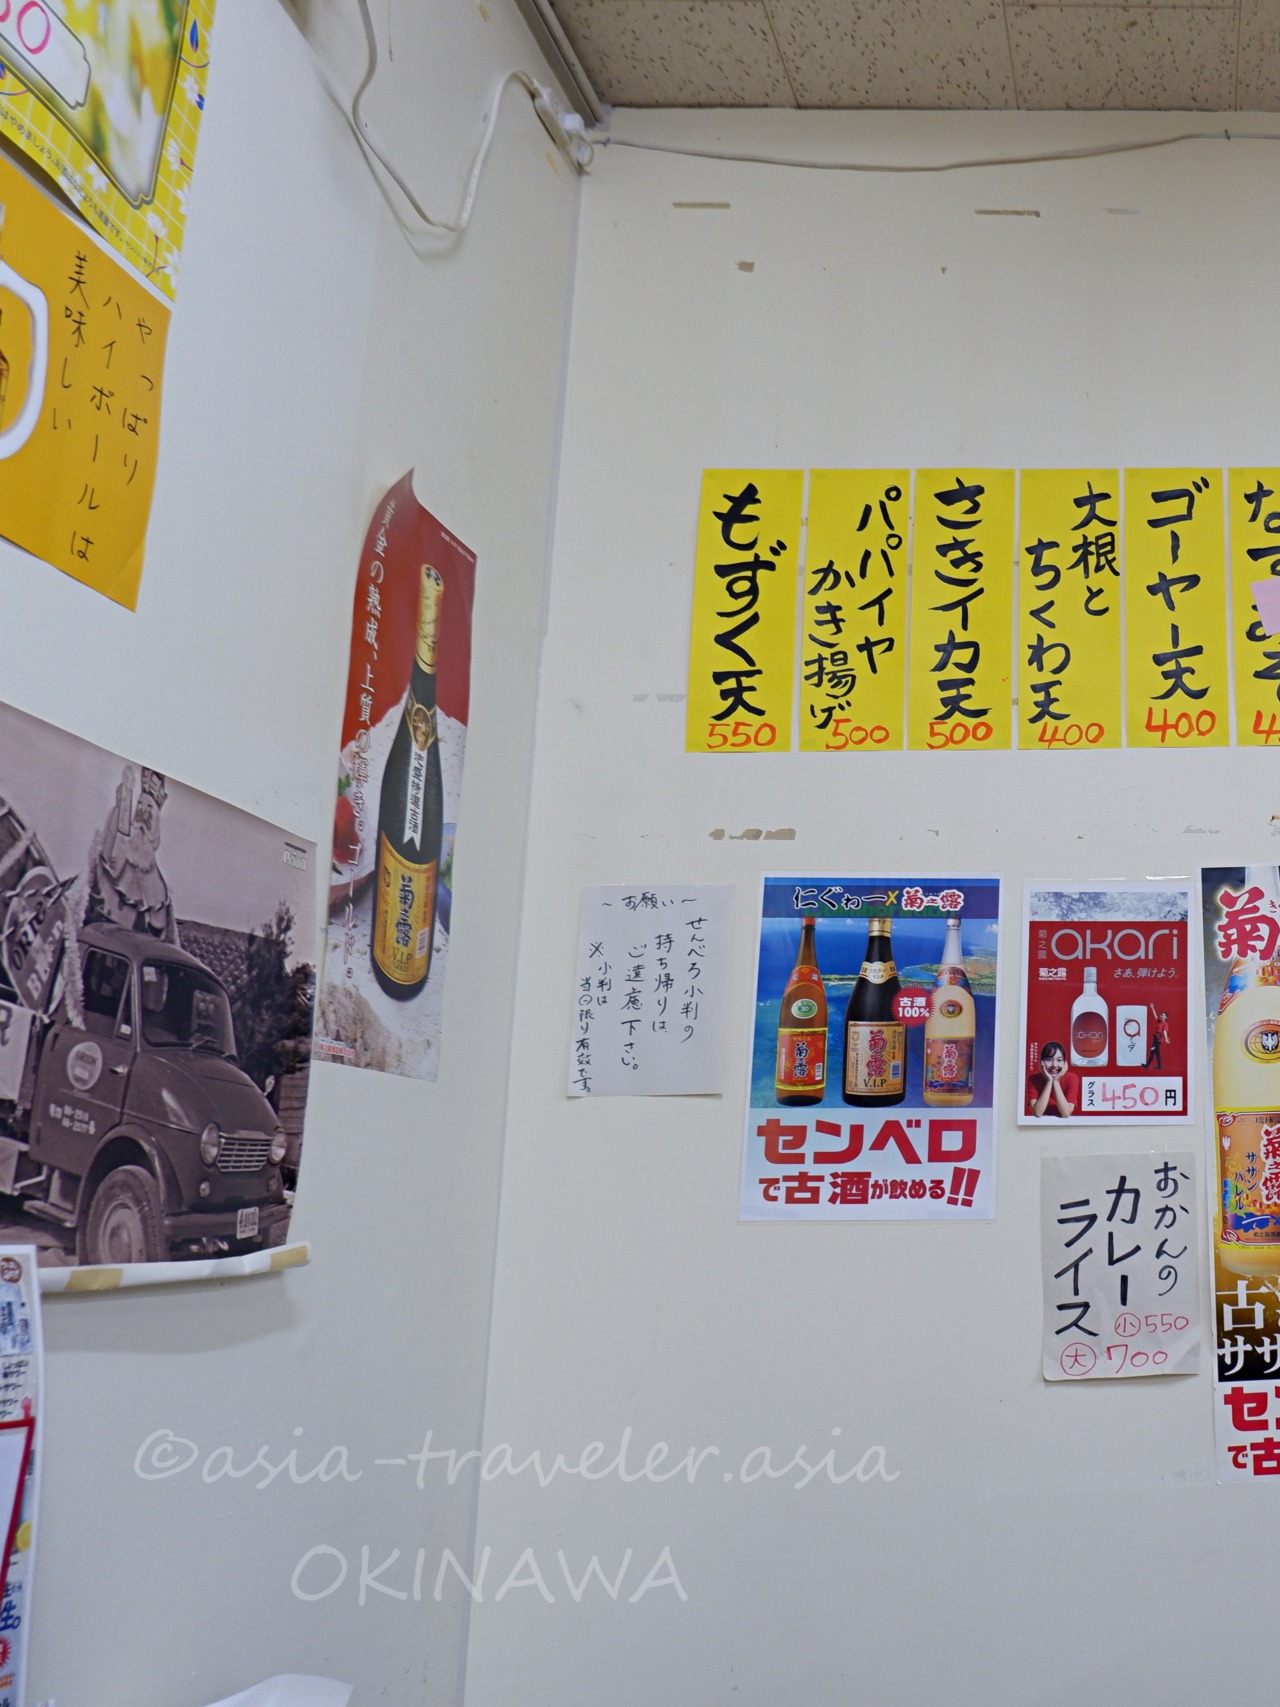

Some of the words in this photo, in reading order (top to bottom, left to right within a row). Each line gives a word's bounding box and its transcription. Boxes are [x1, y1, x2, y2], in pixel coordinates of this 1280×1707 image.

[51, 250, 90, 431] 美味しい
[121, 316, 155, 485] やっぱり
[70, 295, 123, 562] ハイボールは
[1067, 480, 1121, 617] 大根と
[712, 482, 787, 721] もずく天
[855, 485, 902, 675] パパイヤ
[929, 476, 992, 722] さきイカ天
[1146, 476, 1211, 701] ゴーヤー天
[804, 559, 856, 731] かき揚げ
[1024, 538, 1072, 724] ちくわ天
[706, 722, 777, 749] 550
[824, 717, 890, 750] 500
[926, 720, 993, 750] 500
[1038, 721, 1105, 747] 400
[1144, 709, 1217, 738] 400
[902, 886, 965, 912] 菊之露
[1037, 930, 1048, 960] 菊之露
[680, 917, 708, 1043] せんべろ小判の
[1038, 967, 1067, 978] 菊之露
[897, 1007, 931, 1019] 100%
[898, 997, 929, 1008] 古酒
[866, 1029, 887, 1078] 菊之露
[863, 1077, 888, 1089] V.I.P
[1101, 1082, 1160, 1110] 450
[1164, 1088, 1177, 1107] 円
[756, 1118, 978, 1165] センベロ
[1105, 1175, 1142, 1307] カレー
[1154, 1161, 1191, 1297] おかんの
[1053, 1198, 1100, 1337] ライス
[1145, 1314, 1189, 1334] 550
[1106, 1344, 1168, 1374] 700
